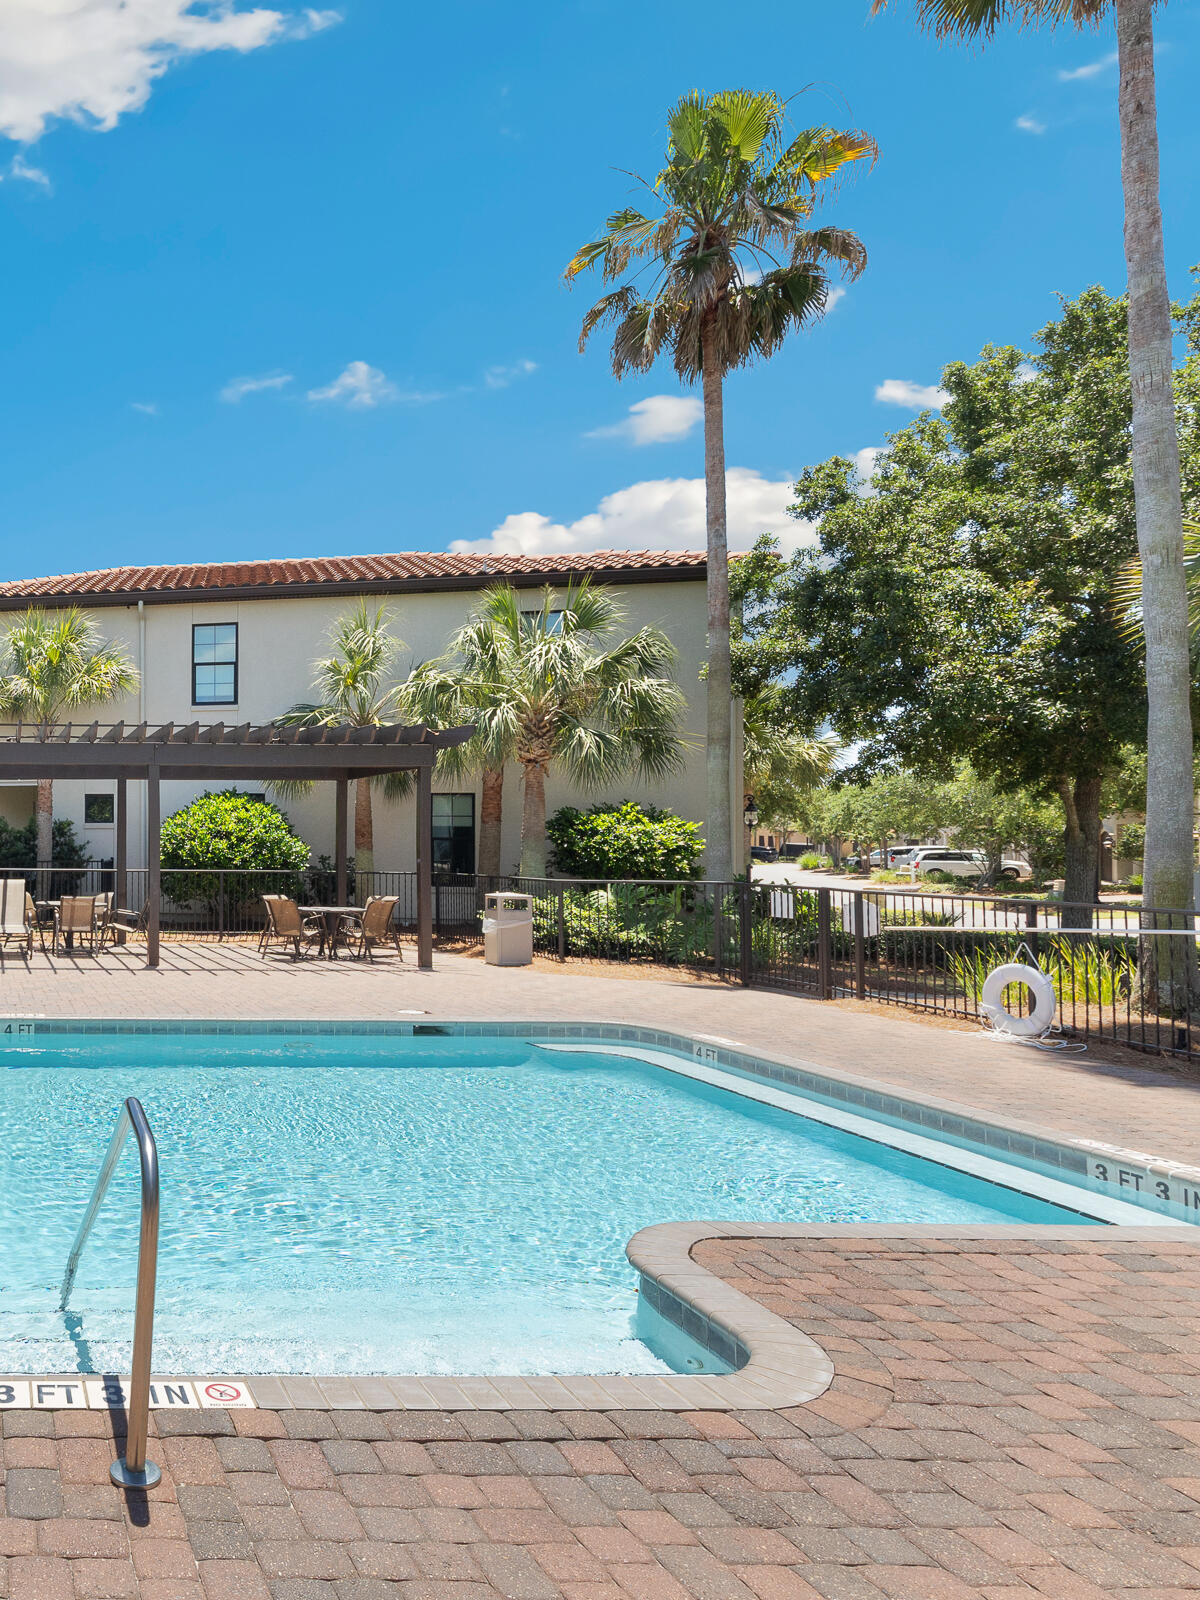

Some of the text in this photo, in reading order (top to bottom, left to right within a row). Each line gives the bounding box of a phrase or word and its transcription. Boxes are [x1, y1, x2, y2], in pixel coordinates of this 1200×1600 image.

[4, 1024, 32, 1034] 4 FT
[696, 1047, 716, 1060] 4 FT
[1095, 1163, 1108, 1181] 3
[1119, 1170, 1143, 1191] FT
[1156, 1181, 1170, 1200] 3
[37, 1384, 78, 1404] FT
[101, 1385, 126, 1404] 3
[150, 1385, 189, 1404] IN
